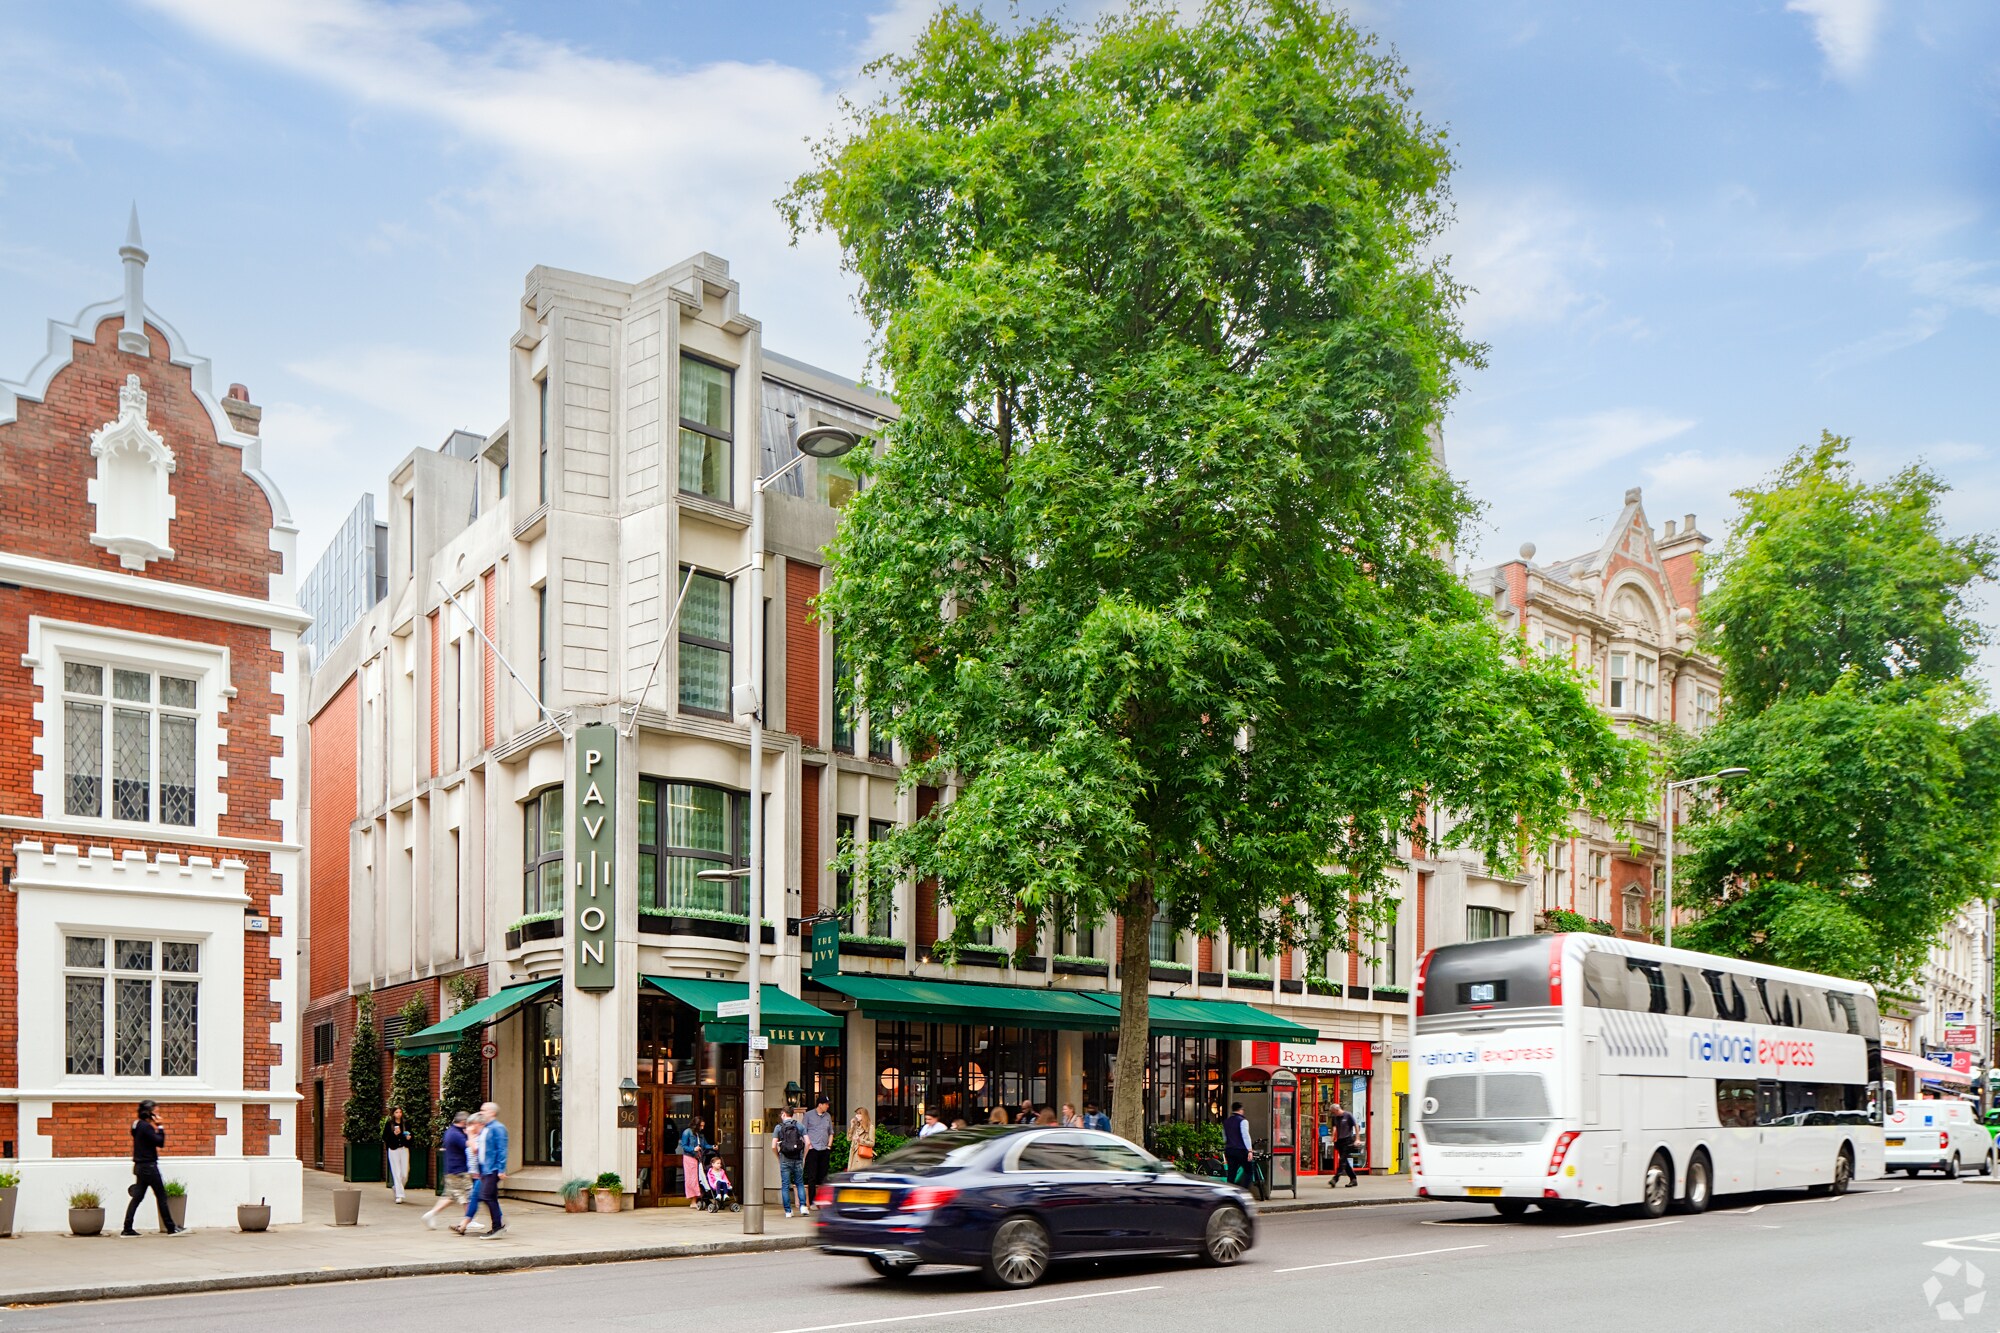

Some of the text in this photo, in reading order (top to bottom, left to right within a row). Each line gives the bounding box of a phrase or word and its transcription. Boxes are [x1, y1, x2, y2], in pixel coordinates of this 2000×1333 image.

[817, 936, 832, 946] THE
[815, 949, 834, 961] IVY
[769, 1029, 825, 1041] THE IVY
[543, 1038, 562, 1056] TH
[1690, 1023, 1813, 1076] national express
[1282, 1050, 1341, 1065] Ryman
[1418, 1046, 1555, 1065] national express
[543, 1067, 560, 1084] IV
[1300, 1067, 1342, 1075] stationer
[620, 1110, 635, 1123] 96
